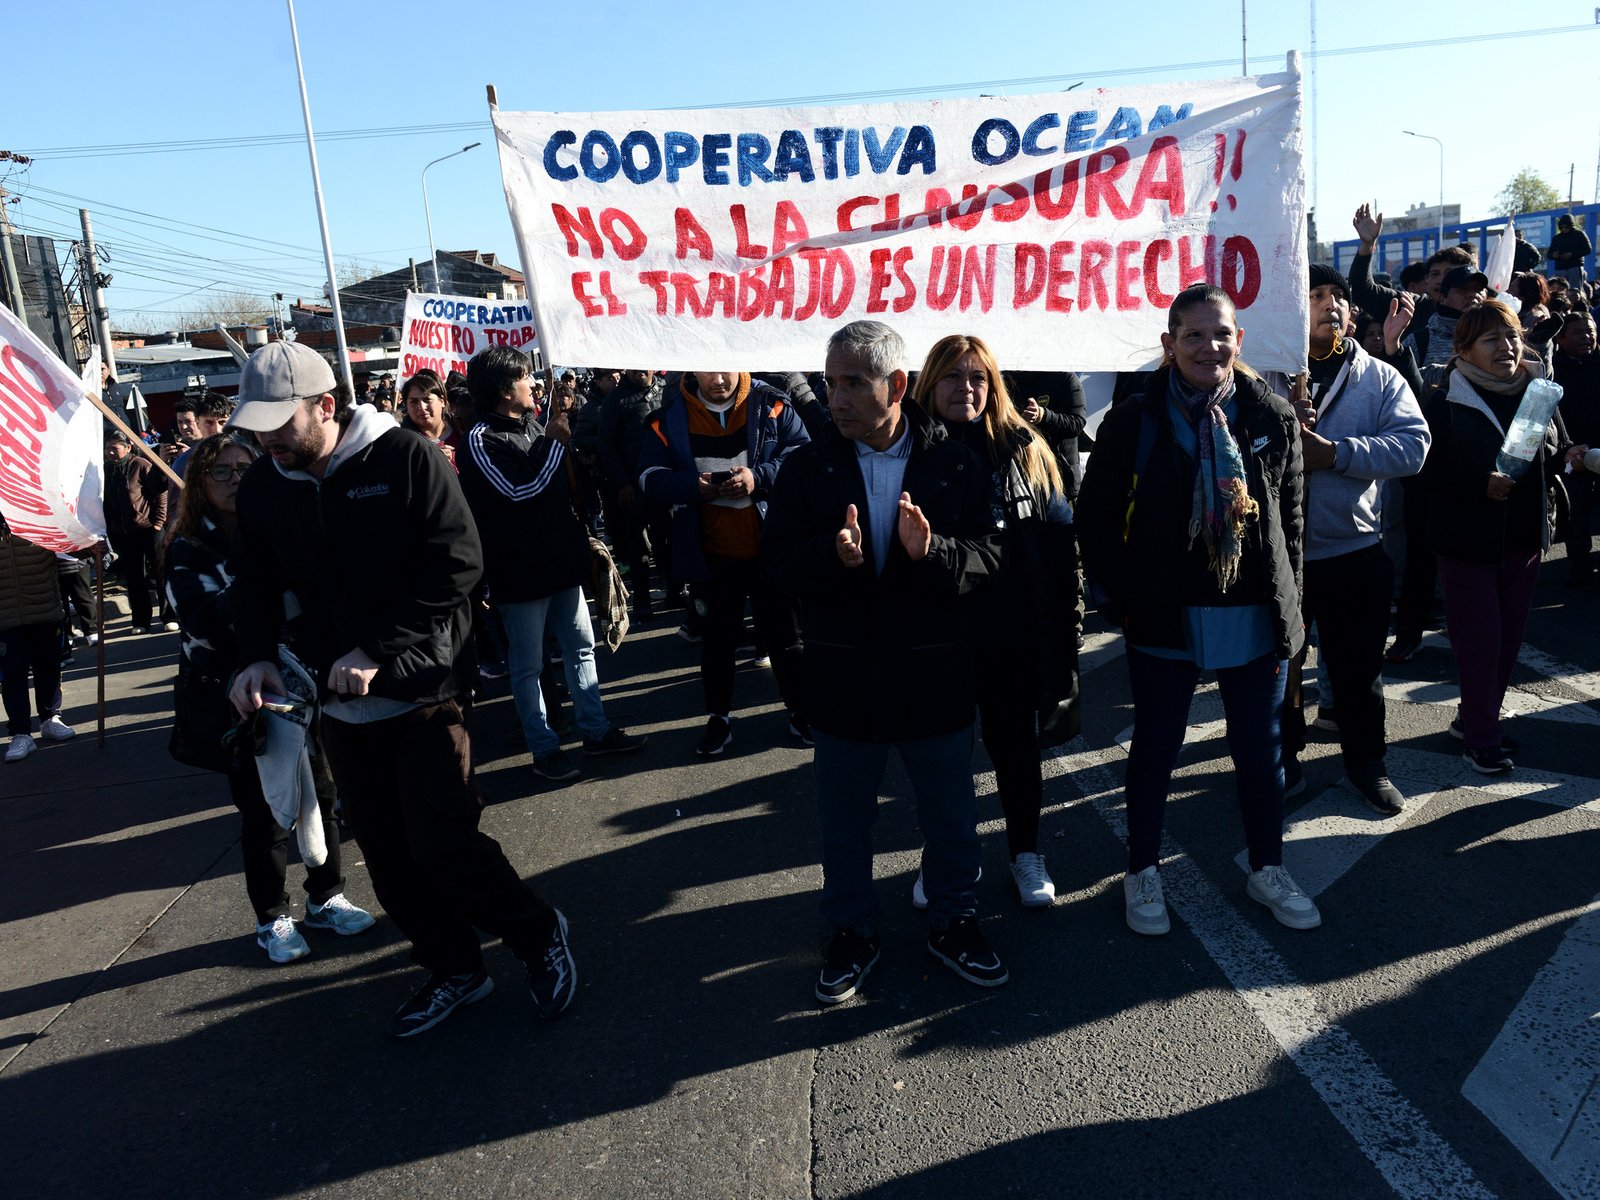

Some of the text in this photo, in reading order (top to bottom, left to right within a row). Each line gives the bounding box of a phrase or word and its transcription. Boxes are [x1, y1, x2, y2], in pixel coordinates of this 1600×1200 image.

[543, 103, 1194, 187] COOPERATIVA OCEAN
[551, 202, 648, 261] NO
[674, 207, 714, 261] A
[729, 200, 810, 260] LA
[837, 135, 1186, 232] CLAUSURA
[571, 234, 1262, 322] EL TRABAJO ES UN DERECHO
[409, 318, 476, 355] NUESTRO
[402, 353, 446, 381] SOMOS
[356, 483, 390, 495] Columbia
